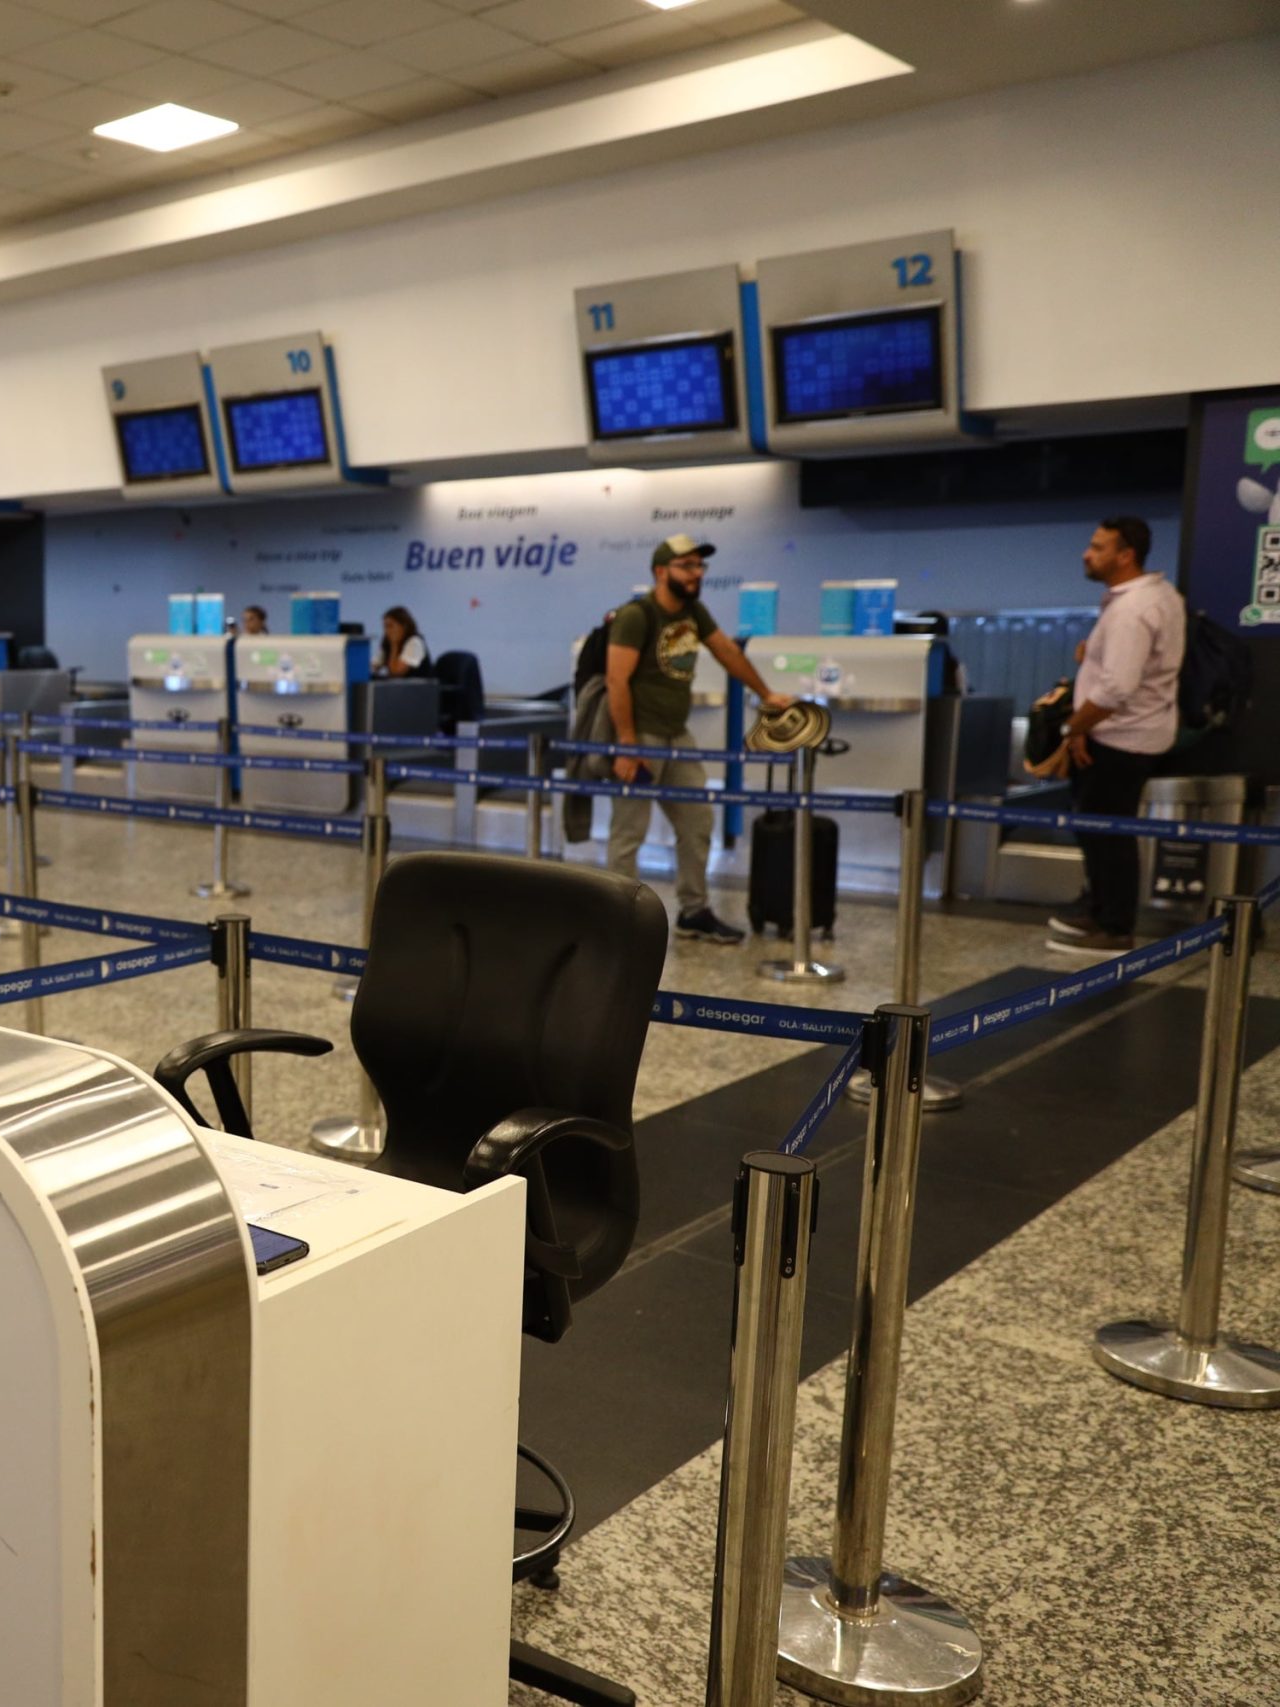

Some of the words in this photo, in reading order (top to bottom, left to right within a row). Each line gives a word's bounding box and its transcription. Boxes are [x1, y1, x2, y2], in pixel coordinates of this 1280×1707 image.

[892, 254, 934, 288] 12
[588, 303, 615, 331] 11
[286, 350, 311, 374] 10
[405, 541, 485, 571] Buen
[494, 534, 578, 576] viaje
[116, 954, 158, 971] despegar
[696, 1006, 766, 1026] despegar
